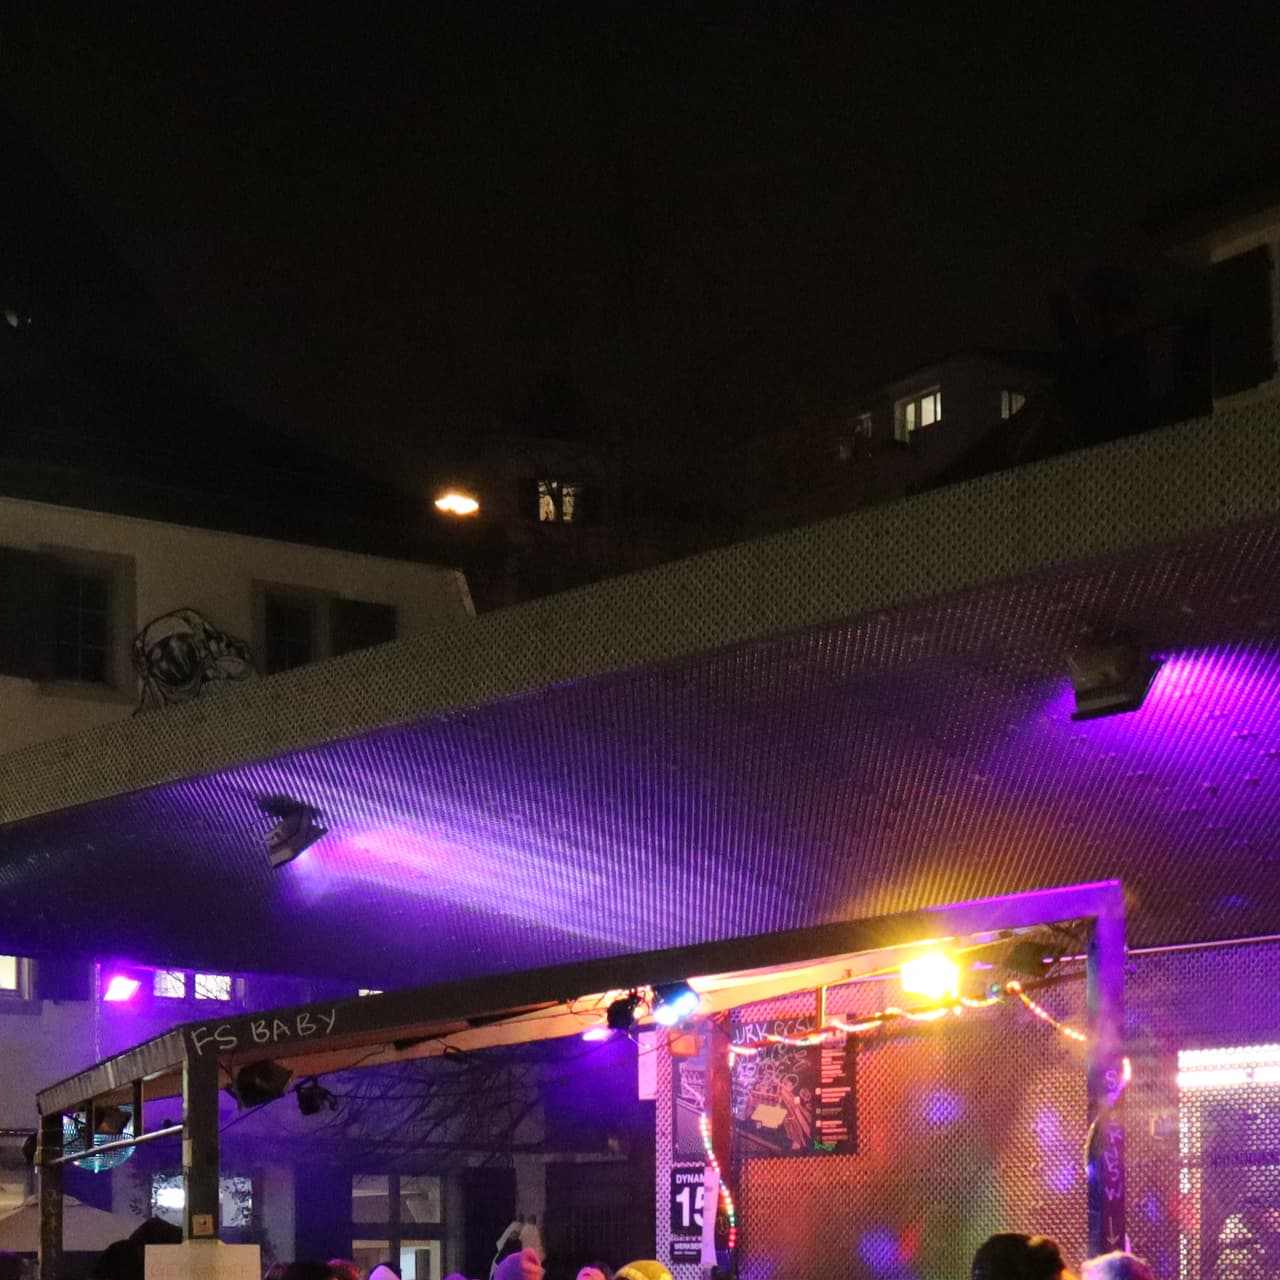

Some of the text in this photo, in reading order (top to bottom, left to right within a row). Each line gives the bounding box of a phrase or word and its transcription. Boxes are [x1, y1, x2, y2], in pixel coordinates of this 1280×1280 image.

[190, 1008, 337, 1056] FS BABY
[675, 1173, 705, 1184] DYNAM
[675, 1186, 704, 1227] 15
